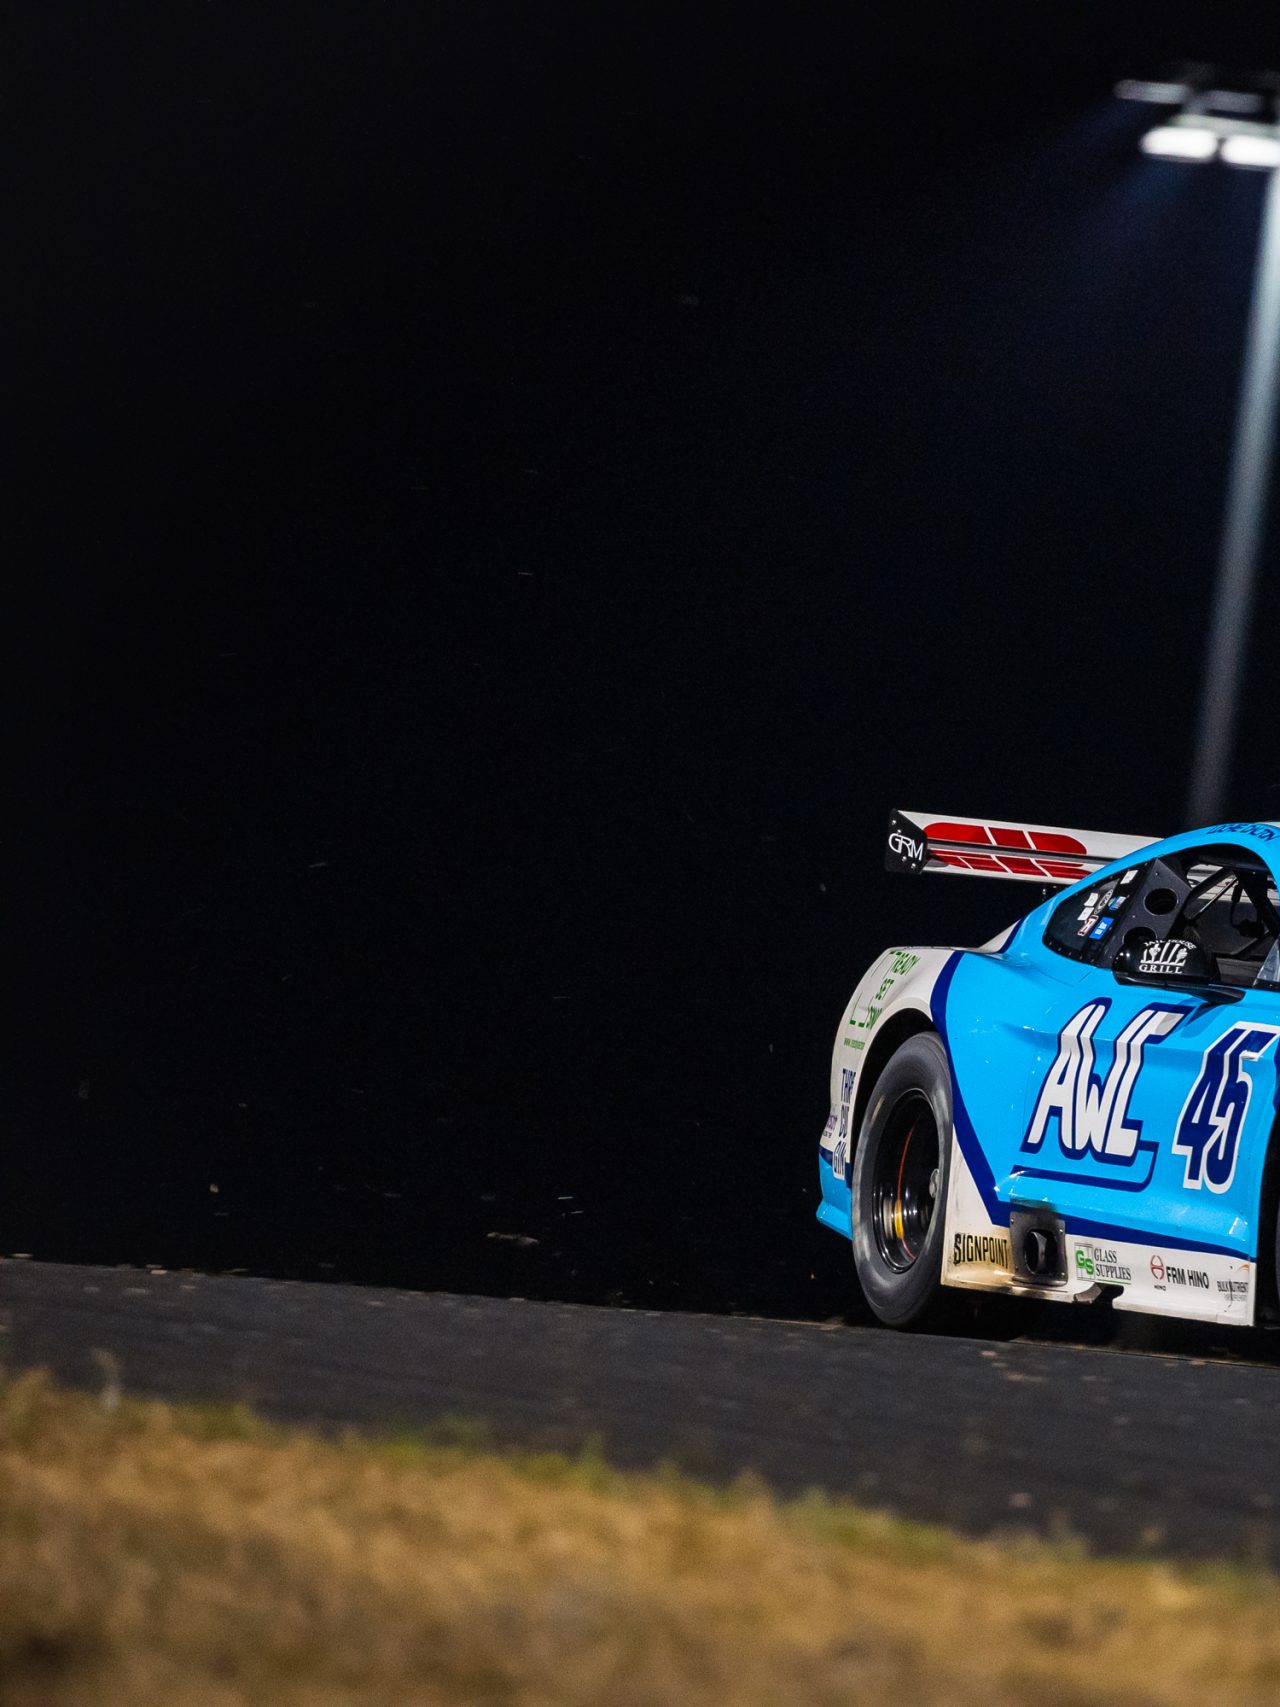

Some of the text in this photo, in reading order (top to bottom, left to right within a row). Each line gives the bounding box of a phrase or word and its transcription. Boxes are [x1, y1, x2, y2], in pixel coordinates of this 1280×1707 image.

[888, 832, 924, 862] GRM
[1138, 963, 1183, 974] GRILL
[952, 1232, 1009, 1270] SIGNPOINT
[1093, 1248, 1118, 1264] GLASS
[1096, 1263, 1133, 1280] SUPPLIES
[1166, 1266, 1210, 1290] FRM HINO
